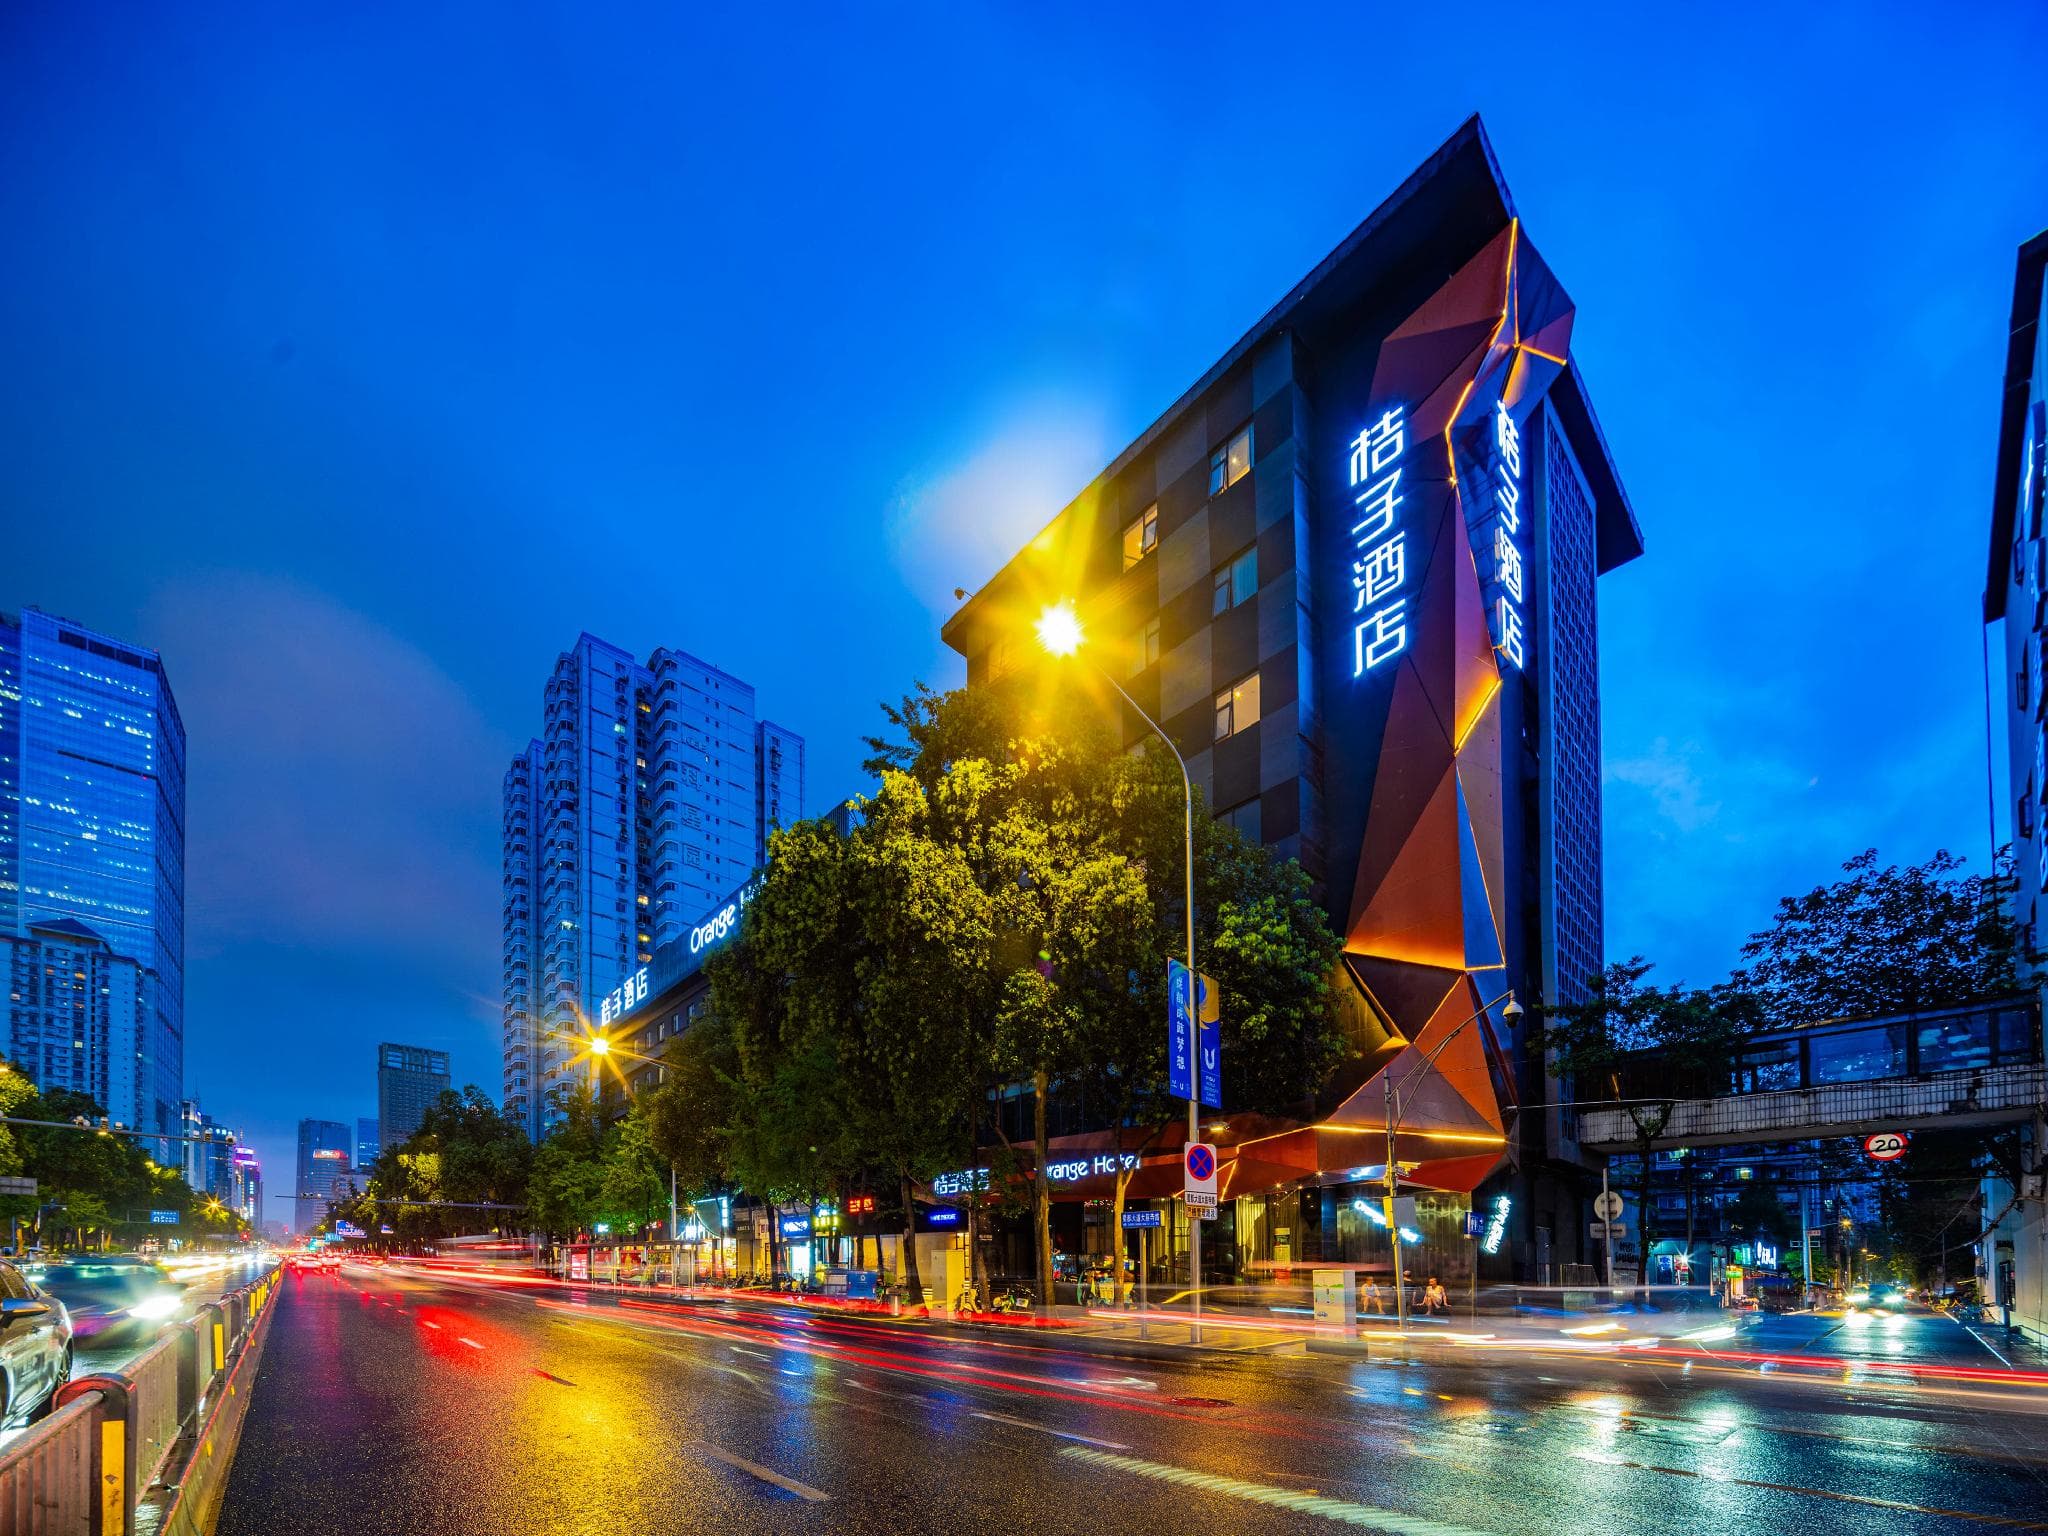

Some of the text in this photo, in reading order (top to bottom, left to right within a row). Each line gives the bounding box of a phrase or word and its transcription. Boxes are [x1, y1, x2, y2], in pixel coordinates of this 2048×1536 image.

[1350, 406, 1406, 677] 桔子酒店
[1498, 399, 1523, 669] 桔子酒店
[690, 904, 736, 954] Orange
[601, 967, 648, 1026] 桔子酒店
[1046, 1161, 1088, 1181] range
[1875, 1138, 1900, 1152] 20
